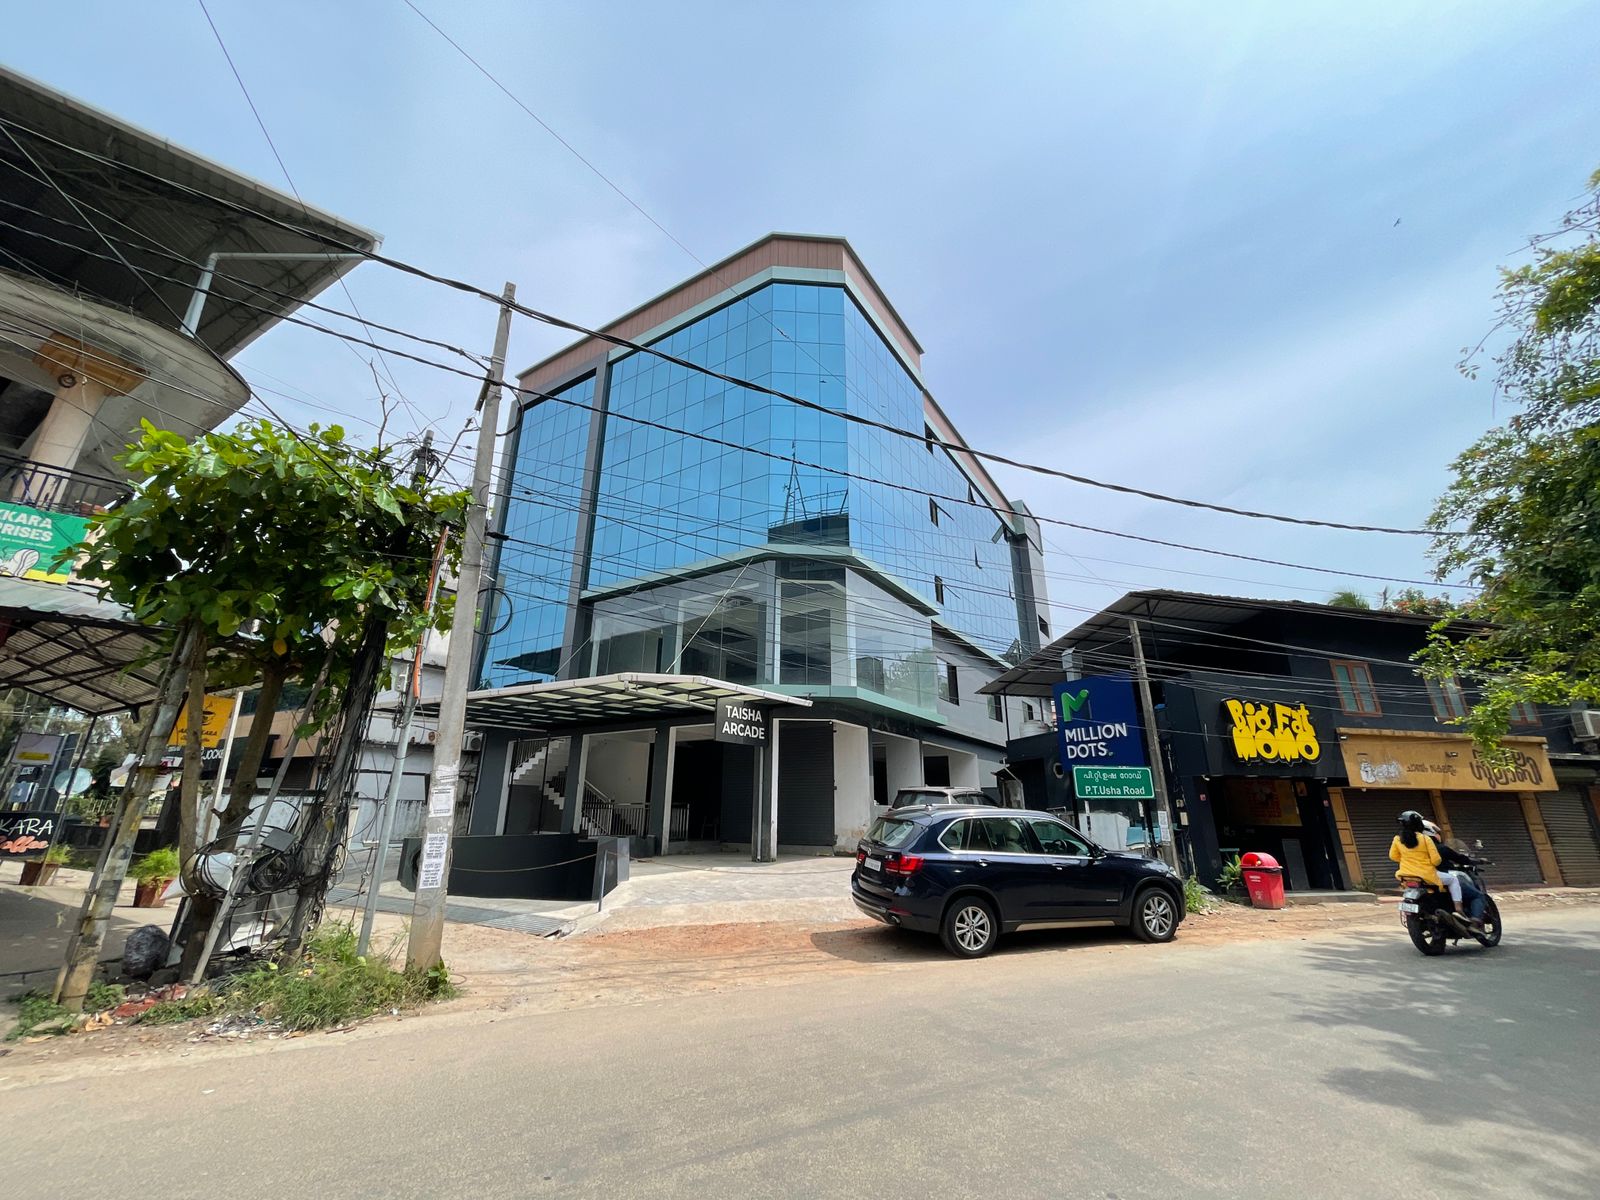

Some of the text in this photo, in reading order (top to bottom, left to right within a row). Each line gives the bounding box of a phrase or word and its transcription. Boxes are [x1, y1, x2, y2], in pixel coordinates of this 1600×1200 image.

[725, 705, 762, 722] TAISHA
[1226, 699, 1316, 737] Big Fat
[722, 721, 765, 739] ARCADE
[1065, 723, 1127, 743] MILLION
[1085, 785, 1145, 795] P.T.Usha Road
